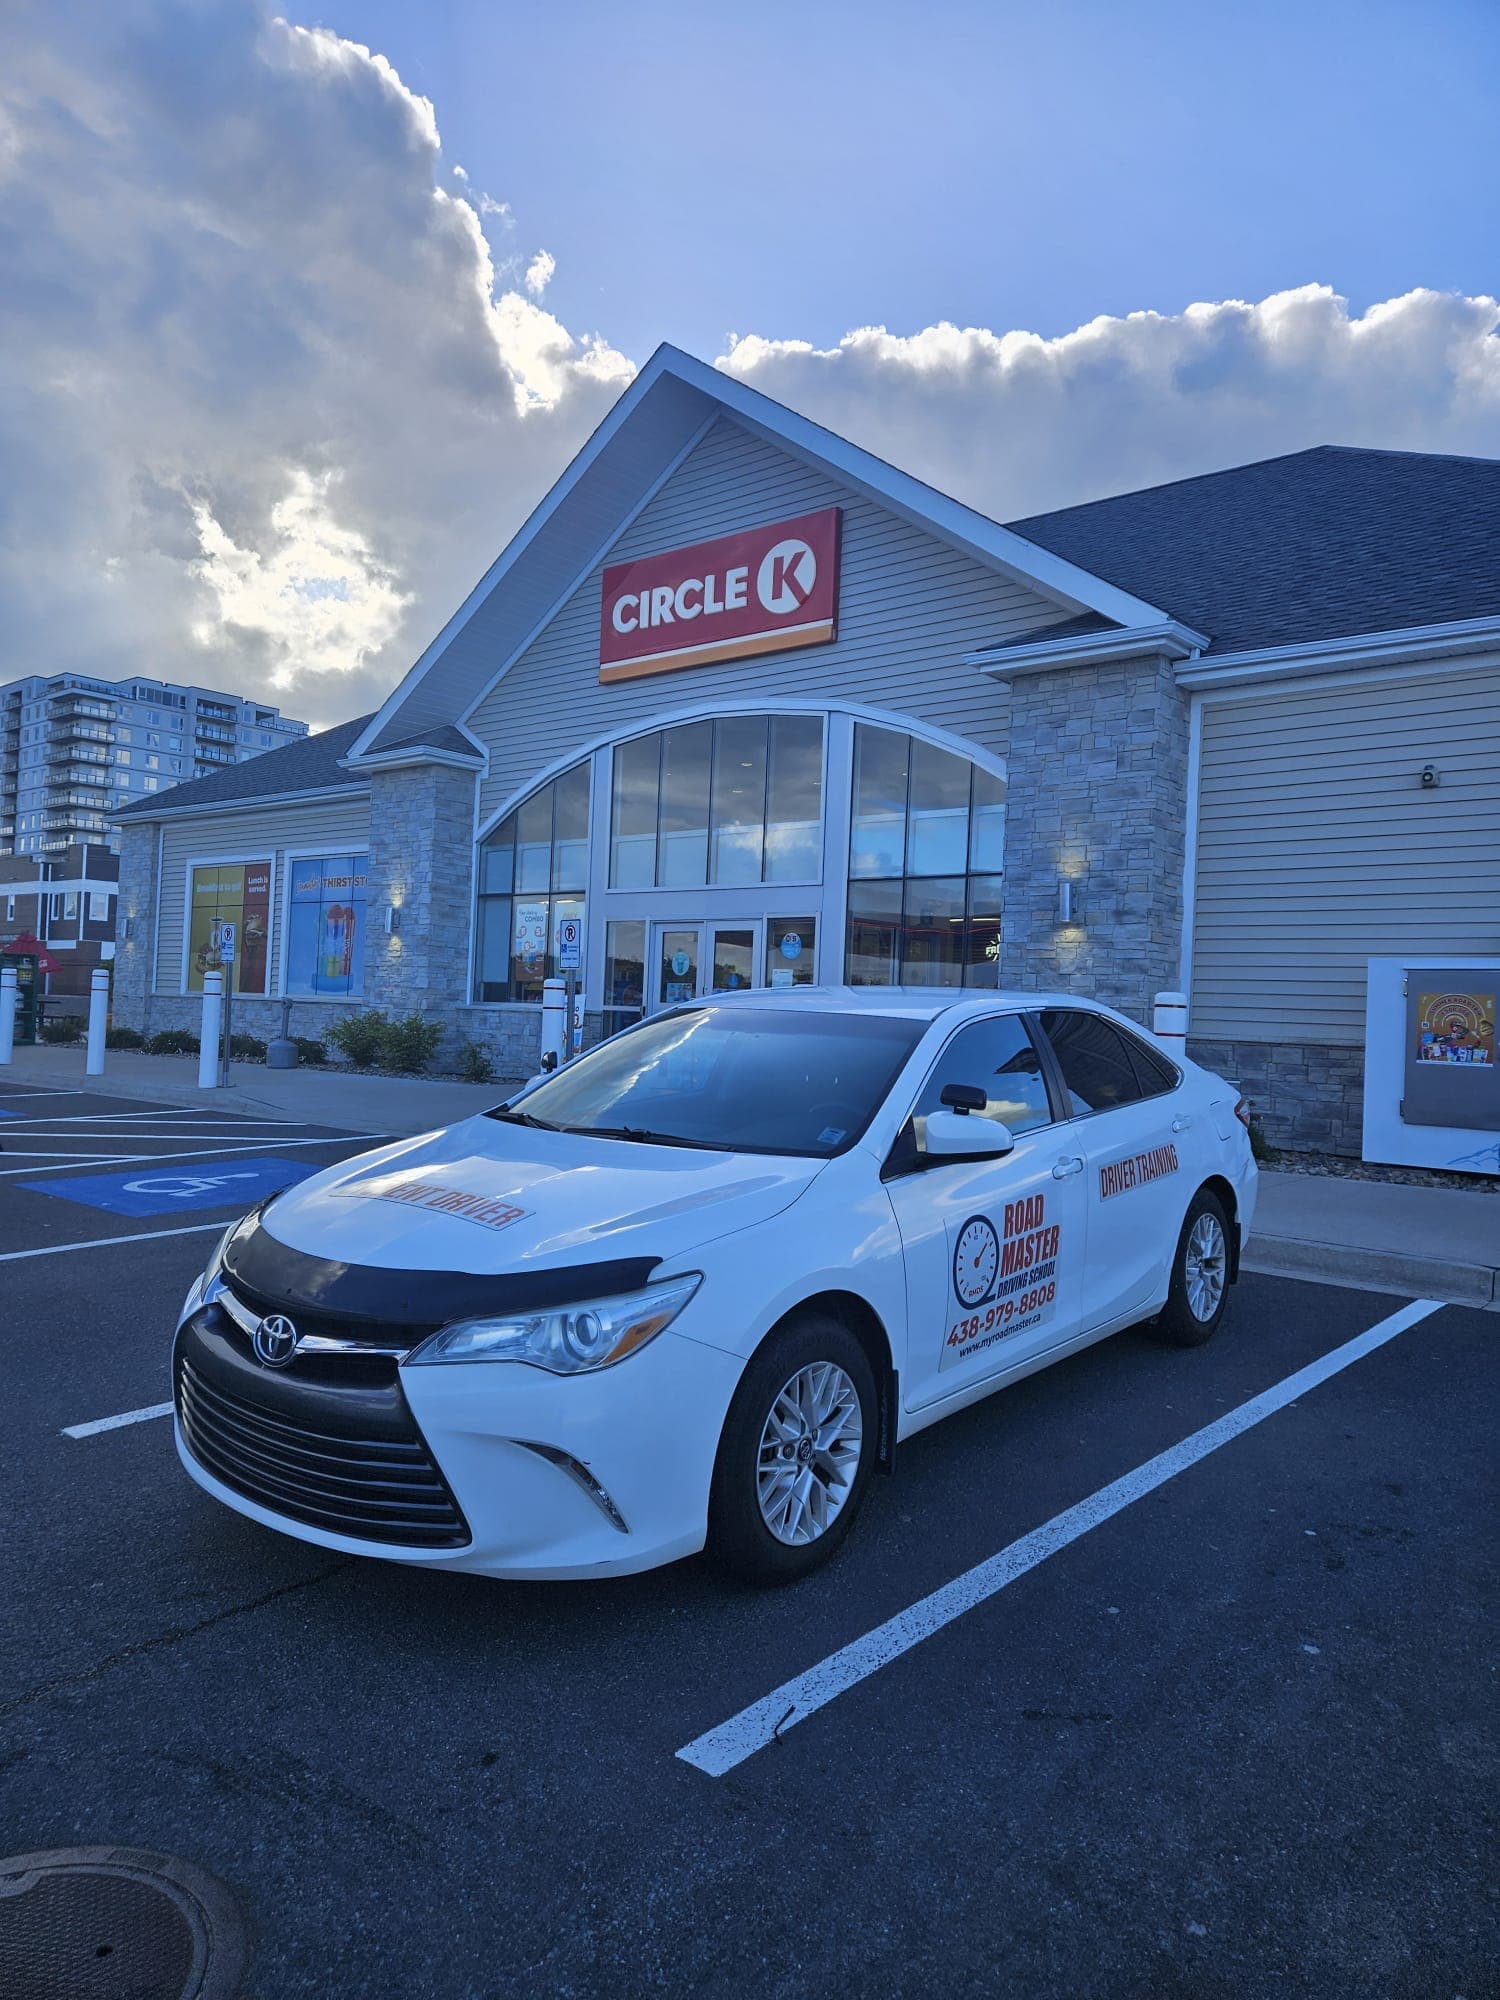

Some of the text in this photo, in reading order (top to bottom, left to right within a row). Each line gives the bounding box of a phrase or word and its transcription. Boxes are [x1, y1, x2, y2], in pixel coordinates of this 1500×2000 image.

[612, 549, 812, 633] CIRCLE K
[322, 876, 353, 889] THIRST
[1101, 1144, 1178, 1198] DRIVER TRAINING
[425, 1191, 525, 1227] DRIVER
[1004, 1194, 1044, 1239] ROAD
[1000, 1225, 1059, 1278] MASTER
[997, 1261, 1055, 1299] DRIVING SCHOOL
[946, 1281, 1056, 1346] 438-979-8808
[960, 1313, 1041, 1358] www.myroadmaster.ca
